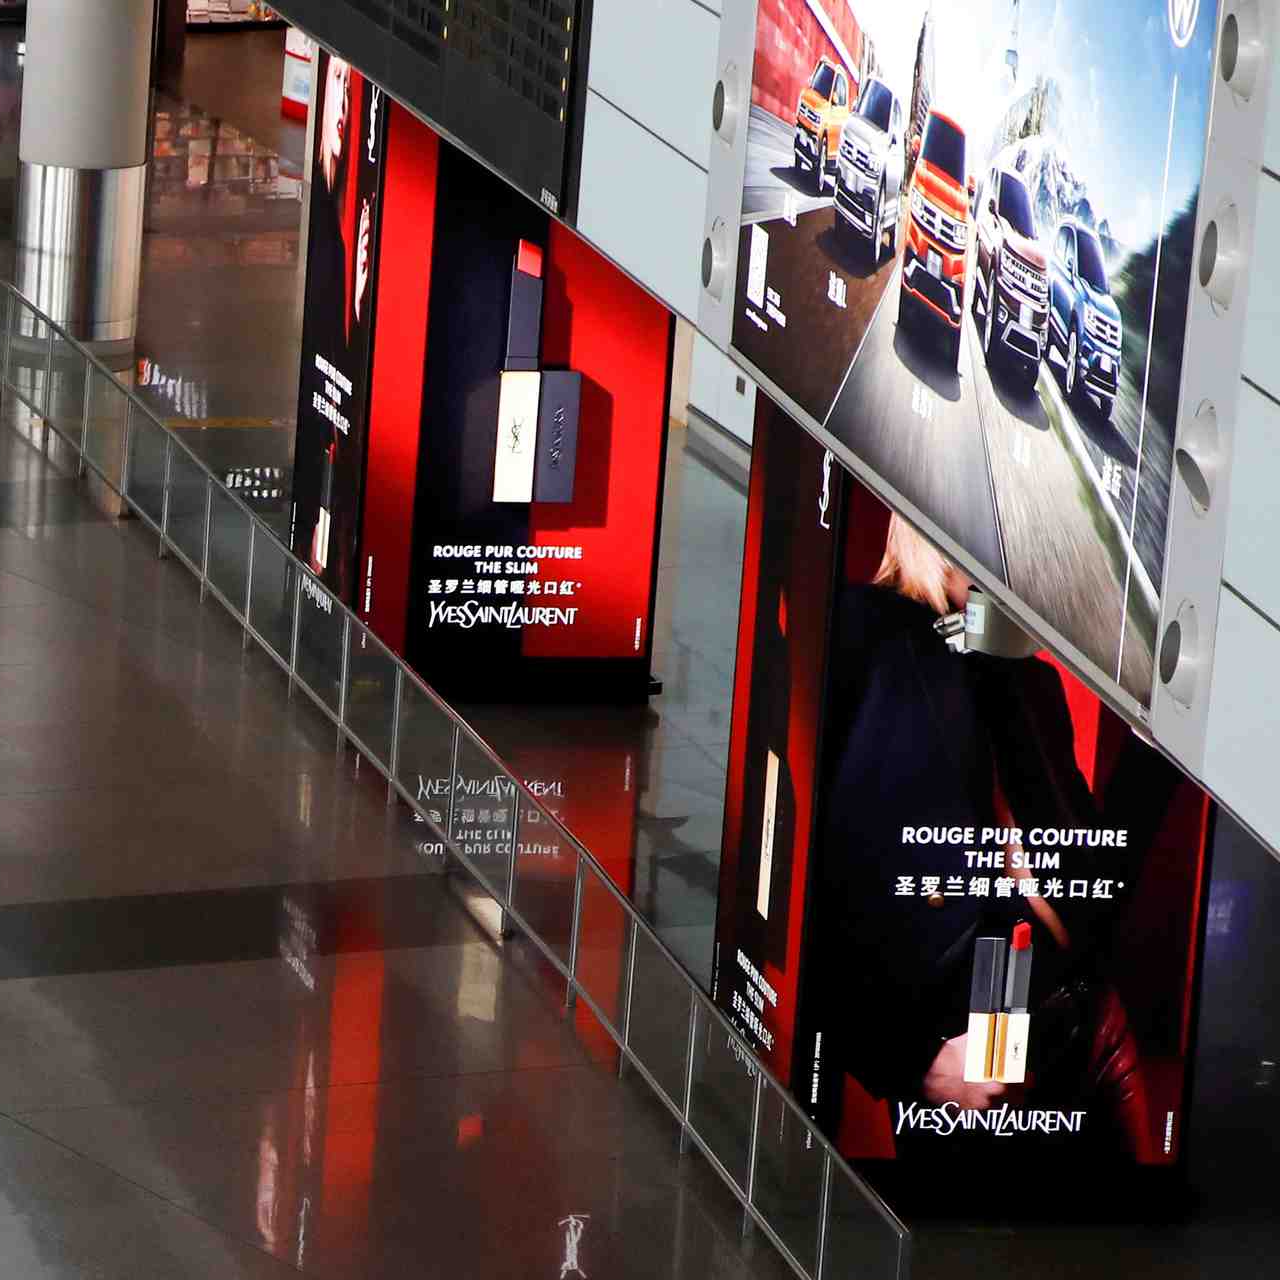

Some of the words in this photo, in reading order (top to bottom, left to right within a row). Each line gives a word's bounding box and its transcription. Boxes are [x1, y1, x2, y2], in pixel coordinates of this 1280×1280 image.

[433, 545, 481, 557] ROUGE
[485, 546, 513, 557] PUR
[517, 546, 582, 559] COUTURE
[475, 561, 501, 573] THE
[505, 562, 537, 574] SLIM
[902, 827, 974, 844] ROUGE
[981, 828, 1023, 845] PUR
[1029, 828, 1127, 847] COUTURE
[965, 851, 1005, 868] THE
[1011, 852, 1060, 869] SLIM
[894, 876, 1114, 898] 圣罗兰细管哑光口红
